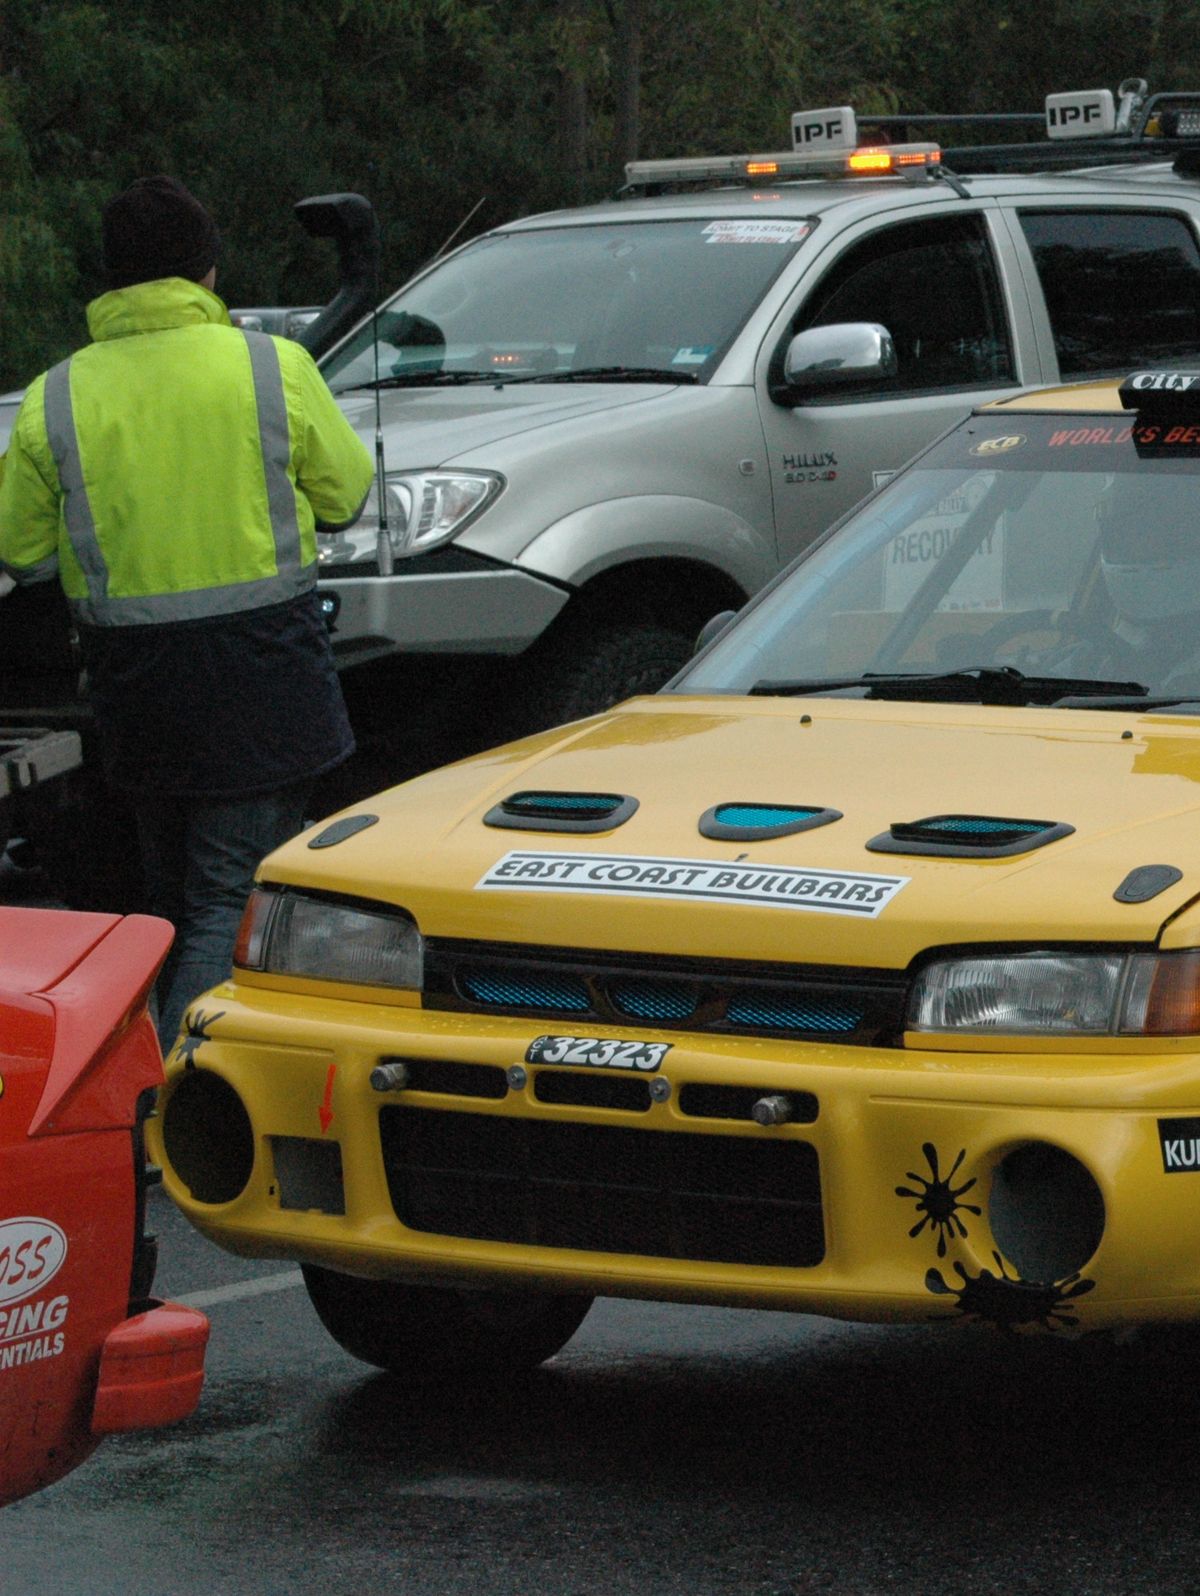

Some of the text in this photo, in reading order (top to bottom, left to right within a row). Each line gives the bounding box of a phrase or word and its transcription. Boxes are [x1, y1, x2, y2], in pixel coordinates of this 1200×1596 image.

[1048, 103, 1101, 127] IPF
[794, 119, 844, 144] IPF
[1132, 373, 1200, 392] City
[1049, 427, 1161, 447] WORLD'S
[783, 451, 838, 469] HILUX
[892, 528, 993, 564] RECOVY
[494, 860, 891, 904] EAST COAST BULLBARS
[543, 1037, 670, 1070] 32323
[0, 1332, 65, 1370] NTIALS
